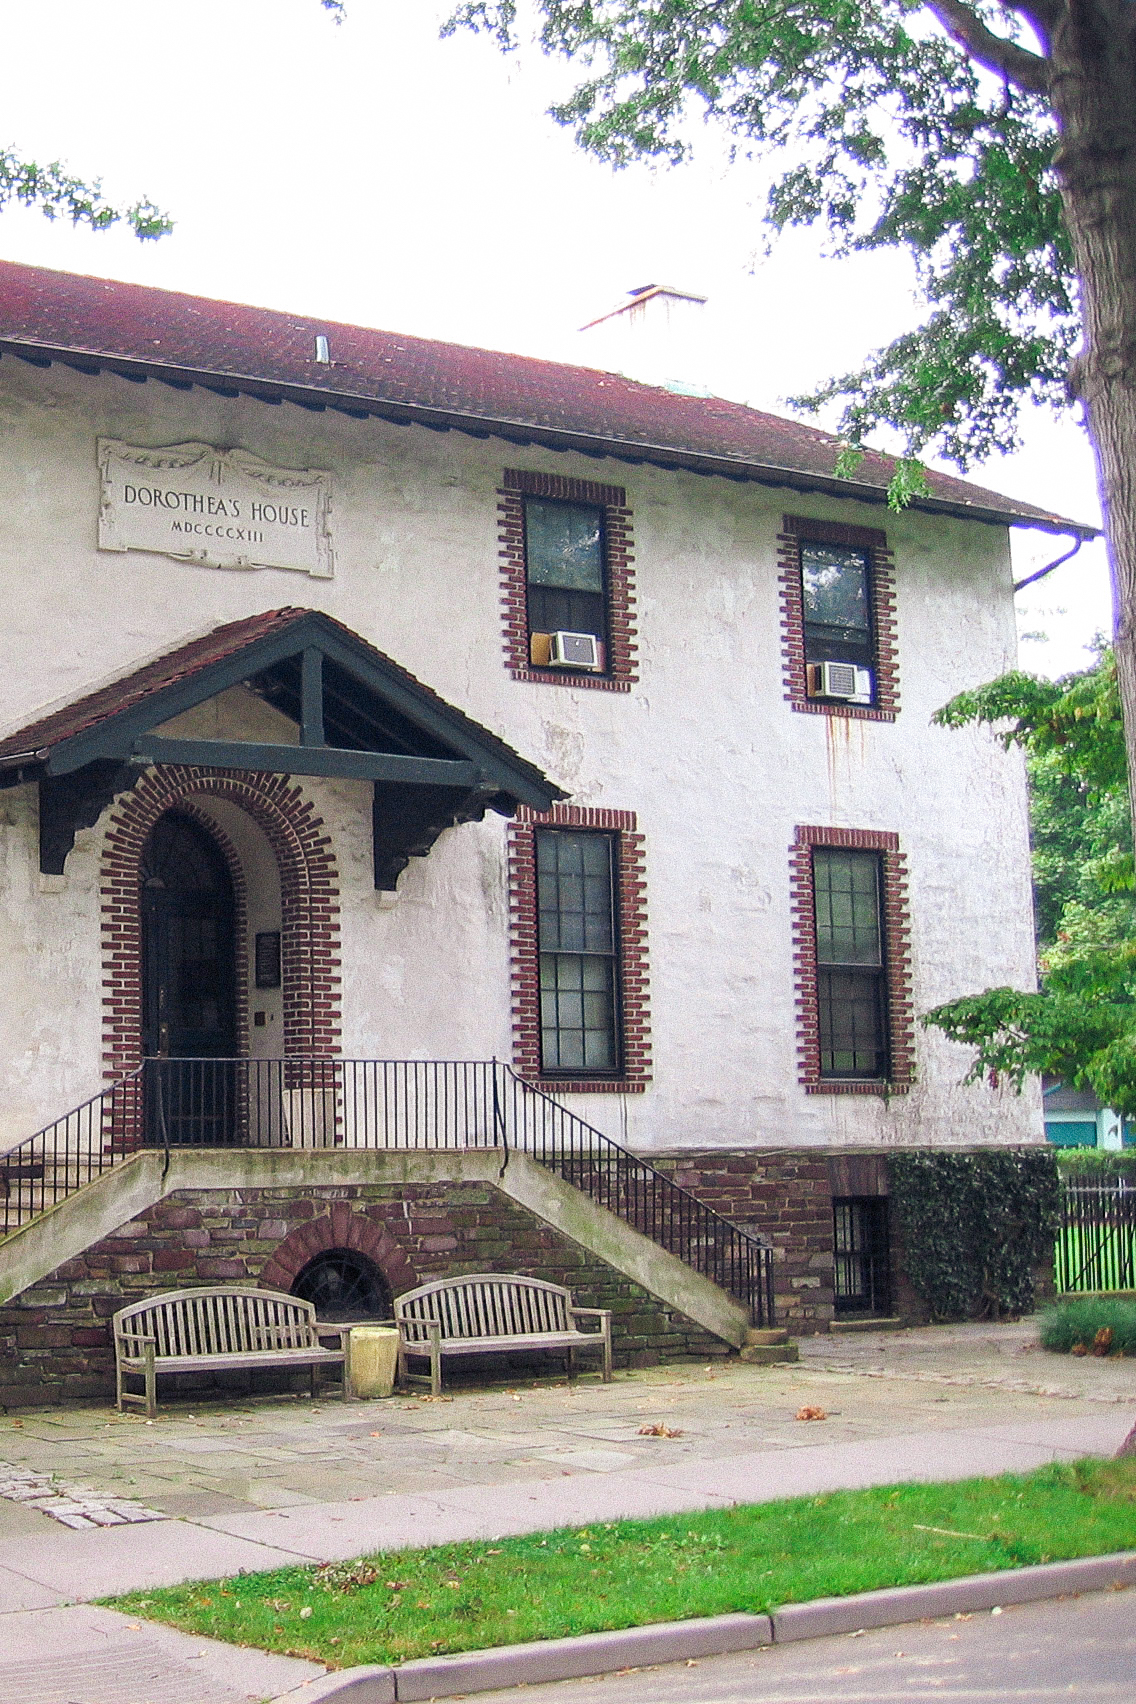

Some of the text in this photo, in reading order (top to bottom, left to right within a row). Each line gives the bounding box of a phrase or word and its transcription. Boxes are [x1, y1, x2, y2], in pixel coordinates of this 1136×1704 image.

[124, 484, 310, 528] DOROTHEA'S HOUSE
[171, 520, 263, 542] MDCCCCXIII
